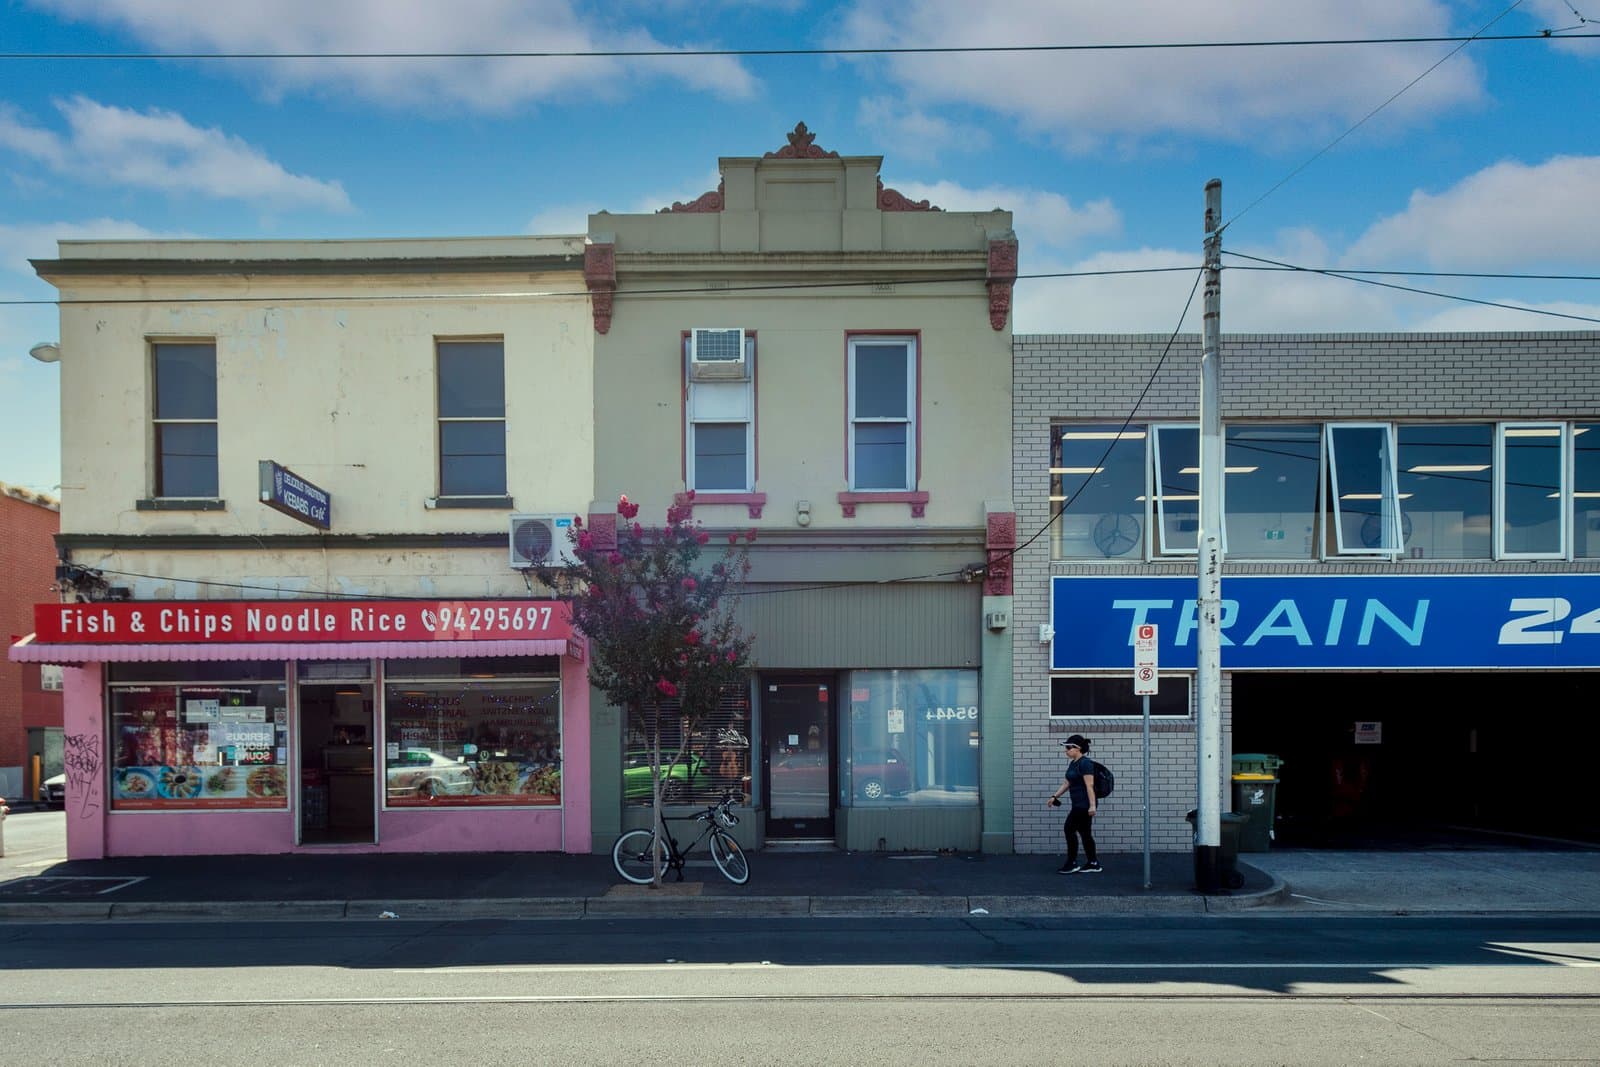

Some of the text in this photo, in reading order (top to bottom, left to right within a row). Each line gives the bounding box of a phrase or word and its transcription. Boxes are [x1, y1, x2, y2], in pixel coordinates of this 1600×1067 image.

[284, 489, 309, 515] KEBABS
[61, 606, 552, 638] Fish & Chips Noodle Rice 94295697
[1112, 599, 1430, 646] TRAIN
[1142, 627, 1151, 638] C
